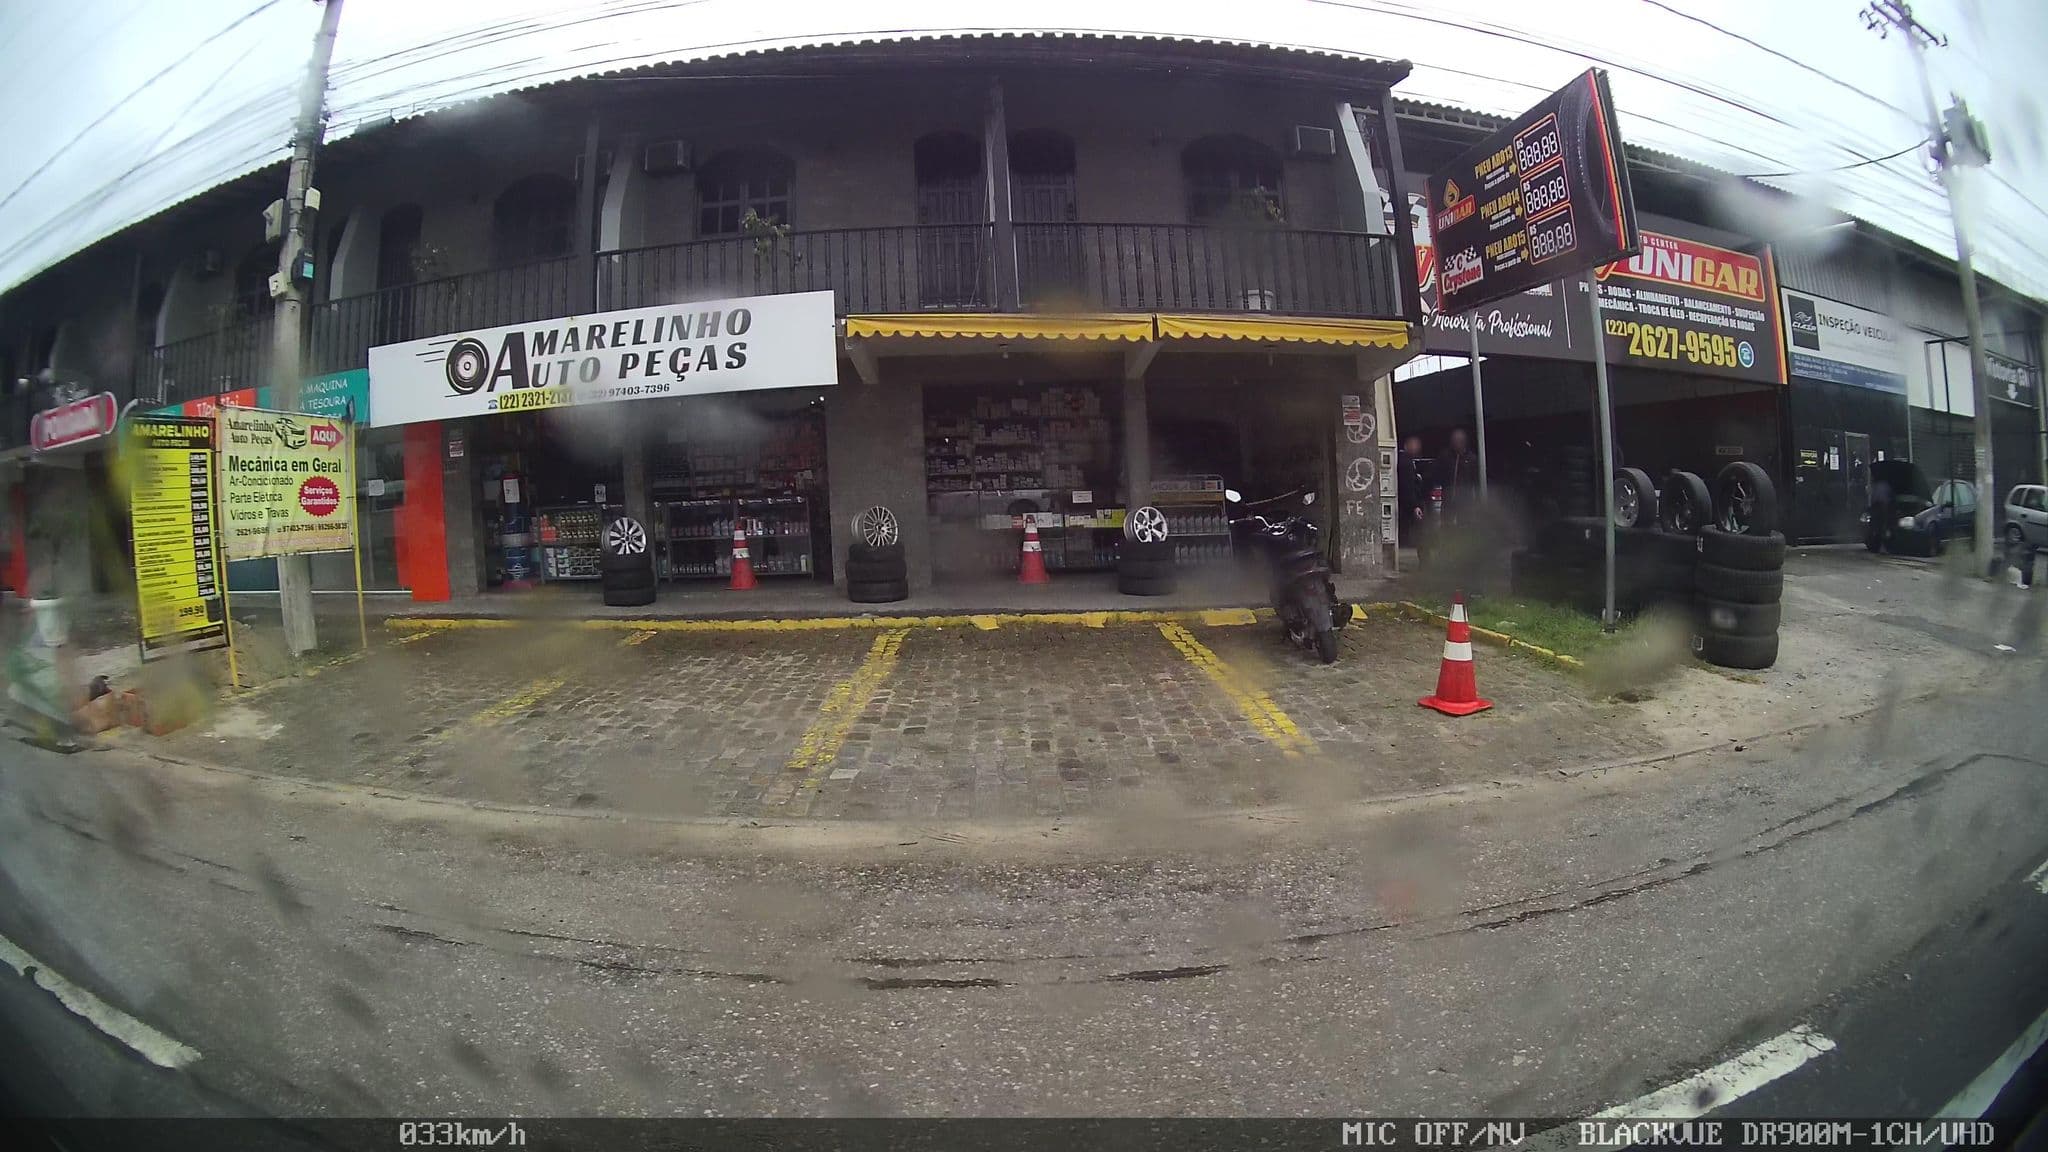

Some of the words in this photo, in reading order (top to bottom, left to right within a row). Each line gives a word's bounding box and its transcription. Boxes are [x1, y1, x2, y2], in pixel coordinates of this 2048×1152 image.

[1519, 131, 1558, 171] 888,88
[1474, 158, 1492, 180] PNEU
[1480, 202, 1498, 220] PNEU
[1497, 188, 1520, 211] ARO14
[1525, 176, 1566, 214] 888,88
[1485, 240, 1503, 260] PNEU
[1503, 229, 1526, 252] ARO15
[1628, 245, 1758, 297] UNICAR
[1488, 310, 1553, 338] Profissional
[1818, 313, 1861, 335] INSPEÇÃO
[487, 308, 752, 392] AMARELINHO
[1605, 319, 1628, 337] (22)
[1626, 322, 1738, 368] 2627-9595
[618, 342, 748, 382] PEÇAS
[609, 383, 670, 398] 97403-7396
[308, 396, 346, 410] TESOURA
[500, 393, 519, 410] (22)
[132, 423, 209, 438] AMARELINHO
[227, 417, 274, 433] Amarelinho
[231, 432, 248, 444] Auto
[251, 433, 273, 446] Peças
[312, 430, 337, 443] AQUI
[228, 454, 288, 472] Mecânica
[291, 459, 309, 469] em
[312, 457, 342, 473] Geral
[229, 474, 294, 487] Ar-Condicionado
[230, 491, 252, 504] Parte
[303, 485, 333, 496] Serviços
[300, 496, 338, 507] Garantidos
[230, 508, 256, 521] Vidros
[265, 507, 290, 519] Travas
